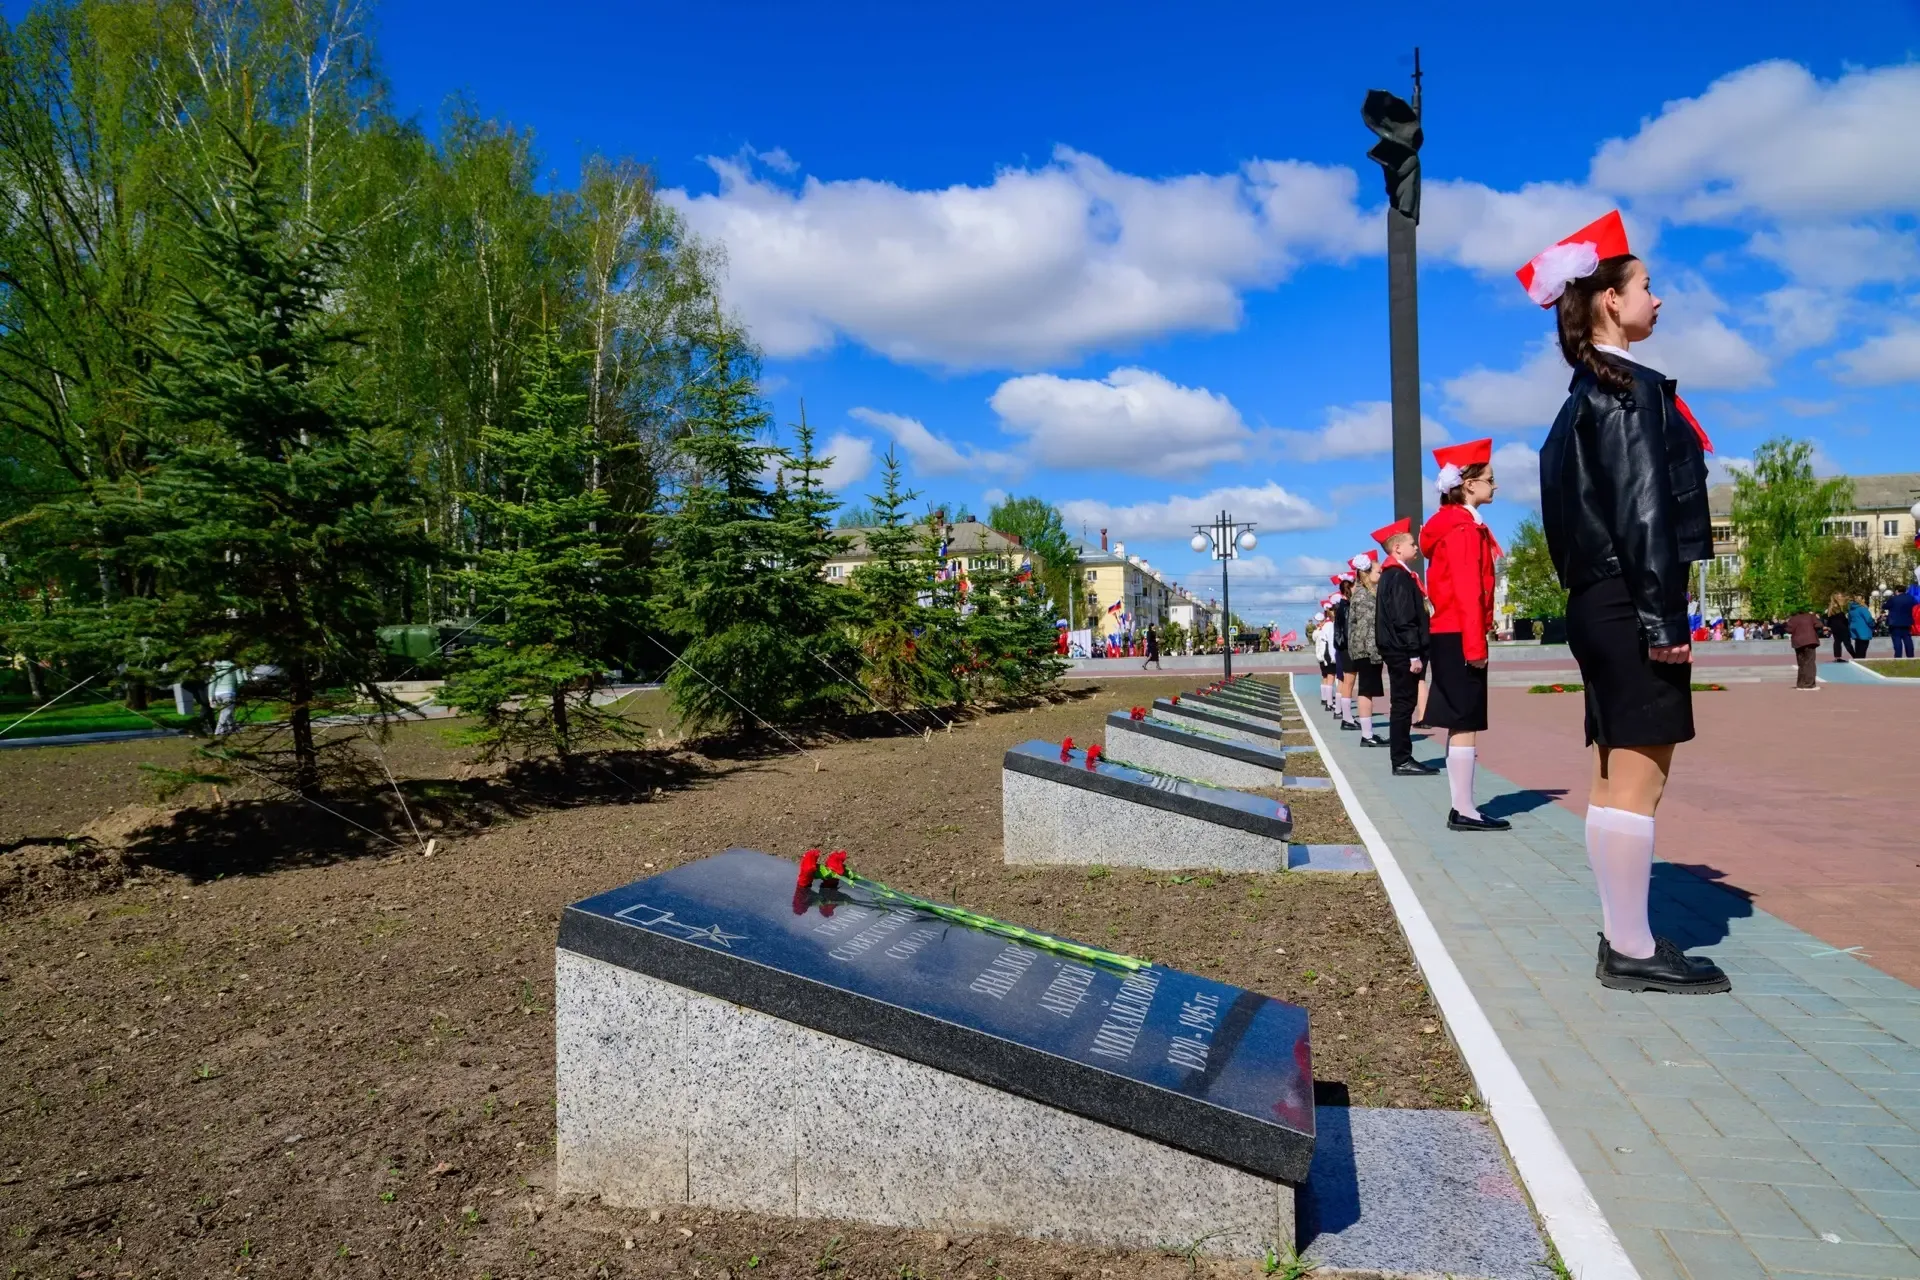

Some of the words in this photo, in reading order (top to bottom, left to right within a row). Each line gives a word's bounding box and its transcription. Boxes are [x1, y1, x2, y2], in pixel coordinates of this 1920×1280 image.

[829, 908, 918, 961] СОВЕТСКОГО
[884, 929, 939, 960] СОЮЗА
[969, 947, 1037, 1000] ЯНАЛОВ
[1037, 962, 1097, 1018] АНДРЕЙ
[1178, 1002, 1217, 1033] 1945
[1194, 992, 1219, 1008] гг.
[1167, 1035, 1210, 1072] 1920
